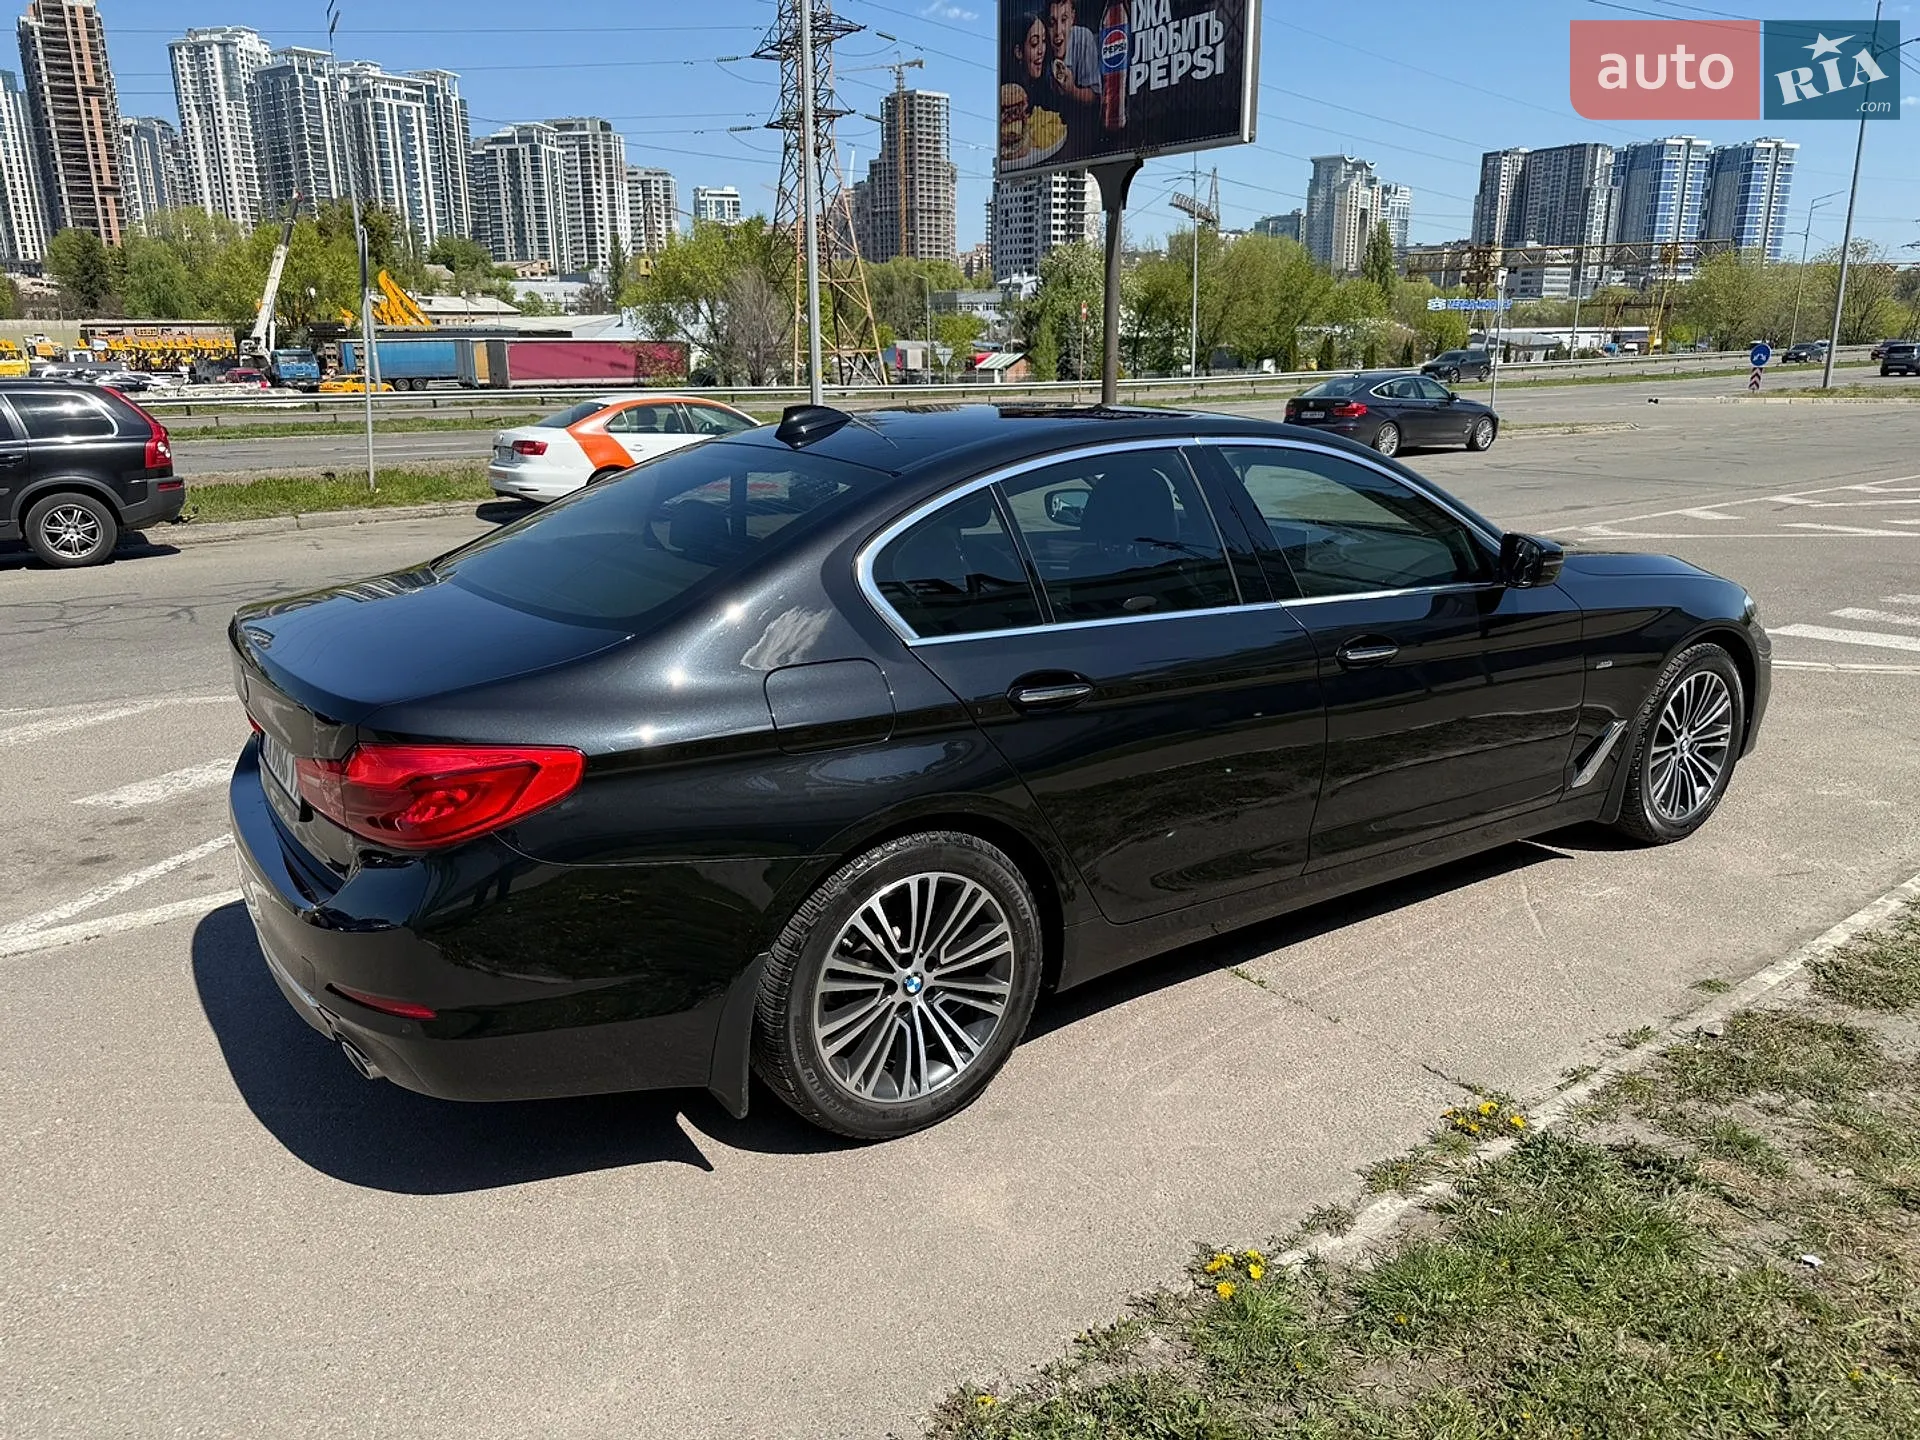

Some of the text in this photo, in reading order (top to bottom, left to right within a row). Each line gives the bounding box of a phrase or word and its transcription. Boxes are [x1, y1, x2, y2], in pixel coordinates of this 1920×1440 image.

[1102, 42, 1127, 55] PEPSI
[1132, 10, 1224, 64] ЛЮБИТЬ
[1129, 41, 1225, 95] PEPSI
